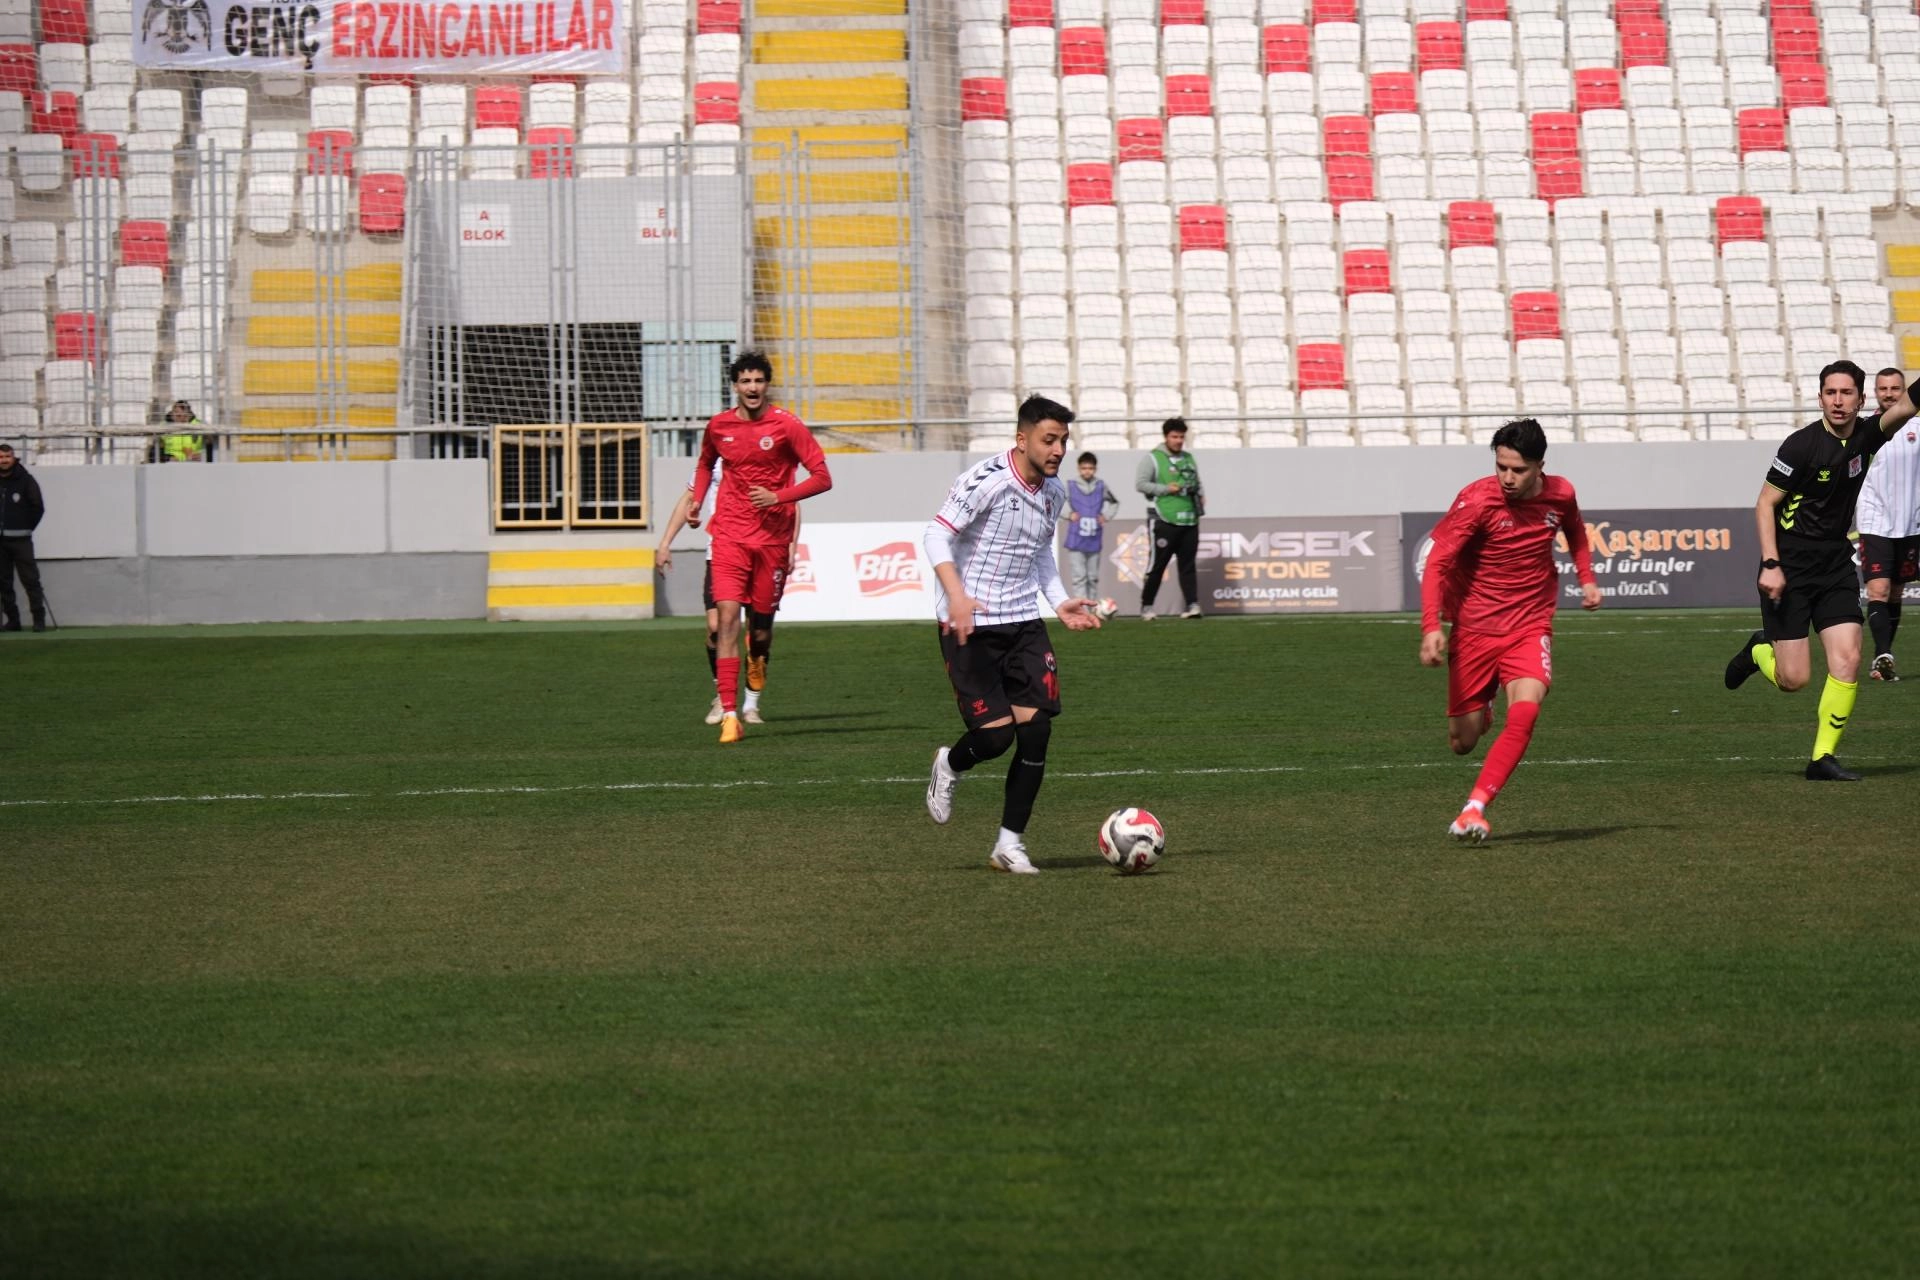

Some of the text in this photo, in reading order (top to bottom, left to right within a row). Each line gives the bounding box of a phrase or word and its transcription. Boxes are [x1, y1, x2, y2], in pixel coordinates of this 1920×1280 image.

[224, 4, 321, 69] GENÇ
[479, 210, 490, 220] A
[462, 229, 506, 241] BLOK
[857, 551, 922, 581] Bifa
[1224, 561, 1331, 580] STONE
[1617, 557, 1695, 576] ürünler
[1213, 586, 1250, 599] GÜCÜ
[1252, 587, 1300, 601] TAŞTAN
[1617, 580, 1669, 597] ÖZGÜN
